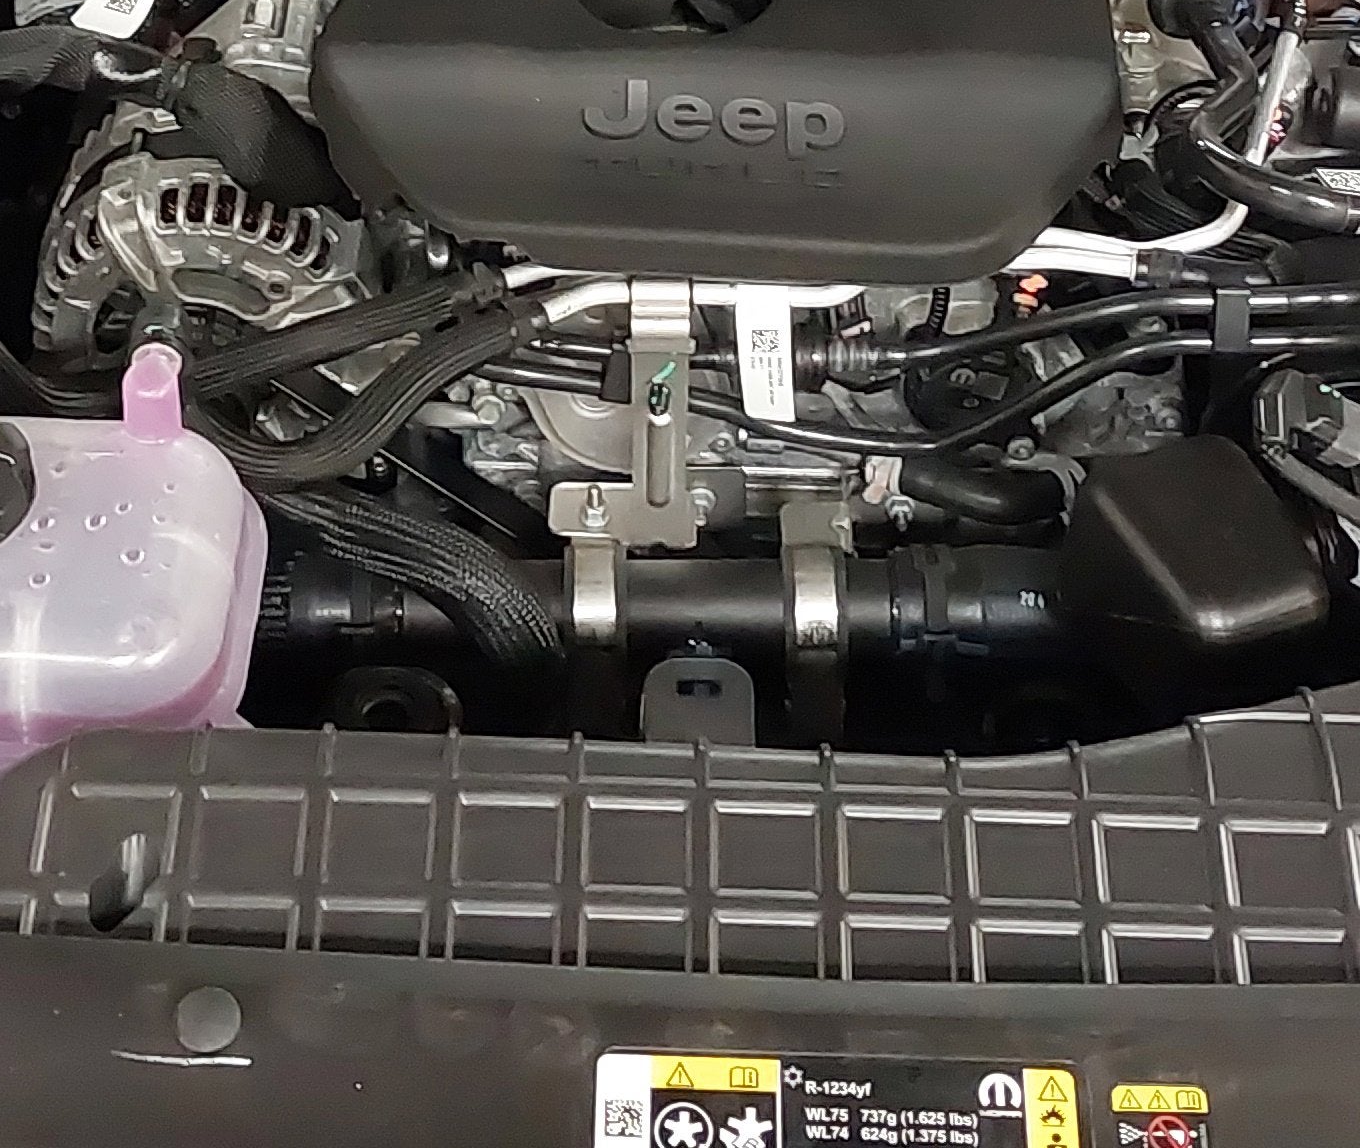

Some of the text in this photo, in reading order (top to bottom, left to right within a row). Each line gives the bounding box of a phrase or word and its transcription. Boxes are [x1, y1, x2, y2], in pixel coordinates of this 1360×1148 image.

[582, 79, 846, 157] Jeep
[804, 1080, 872, 1099] R-1234yf
[804, 1107, 849, 1122] WL75
[860, 1109, 897, 1126] 737g
[901, 1109, 946, 1126] (1.625
[949, 1110, 978, 1128] lbs)
[806, 1125, 979, 1147] WL74 624g (1.375 lbs)
